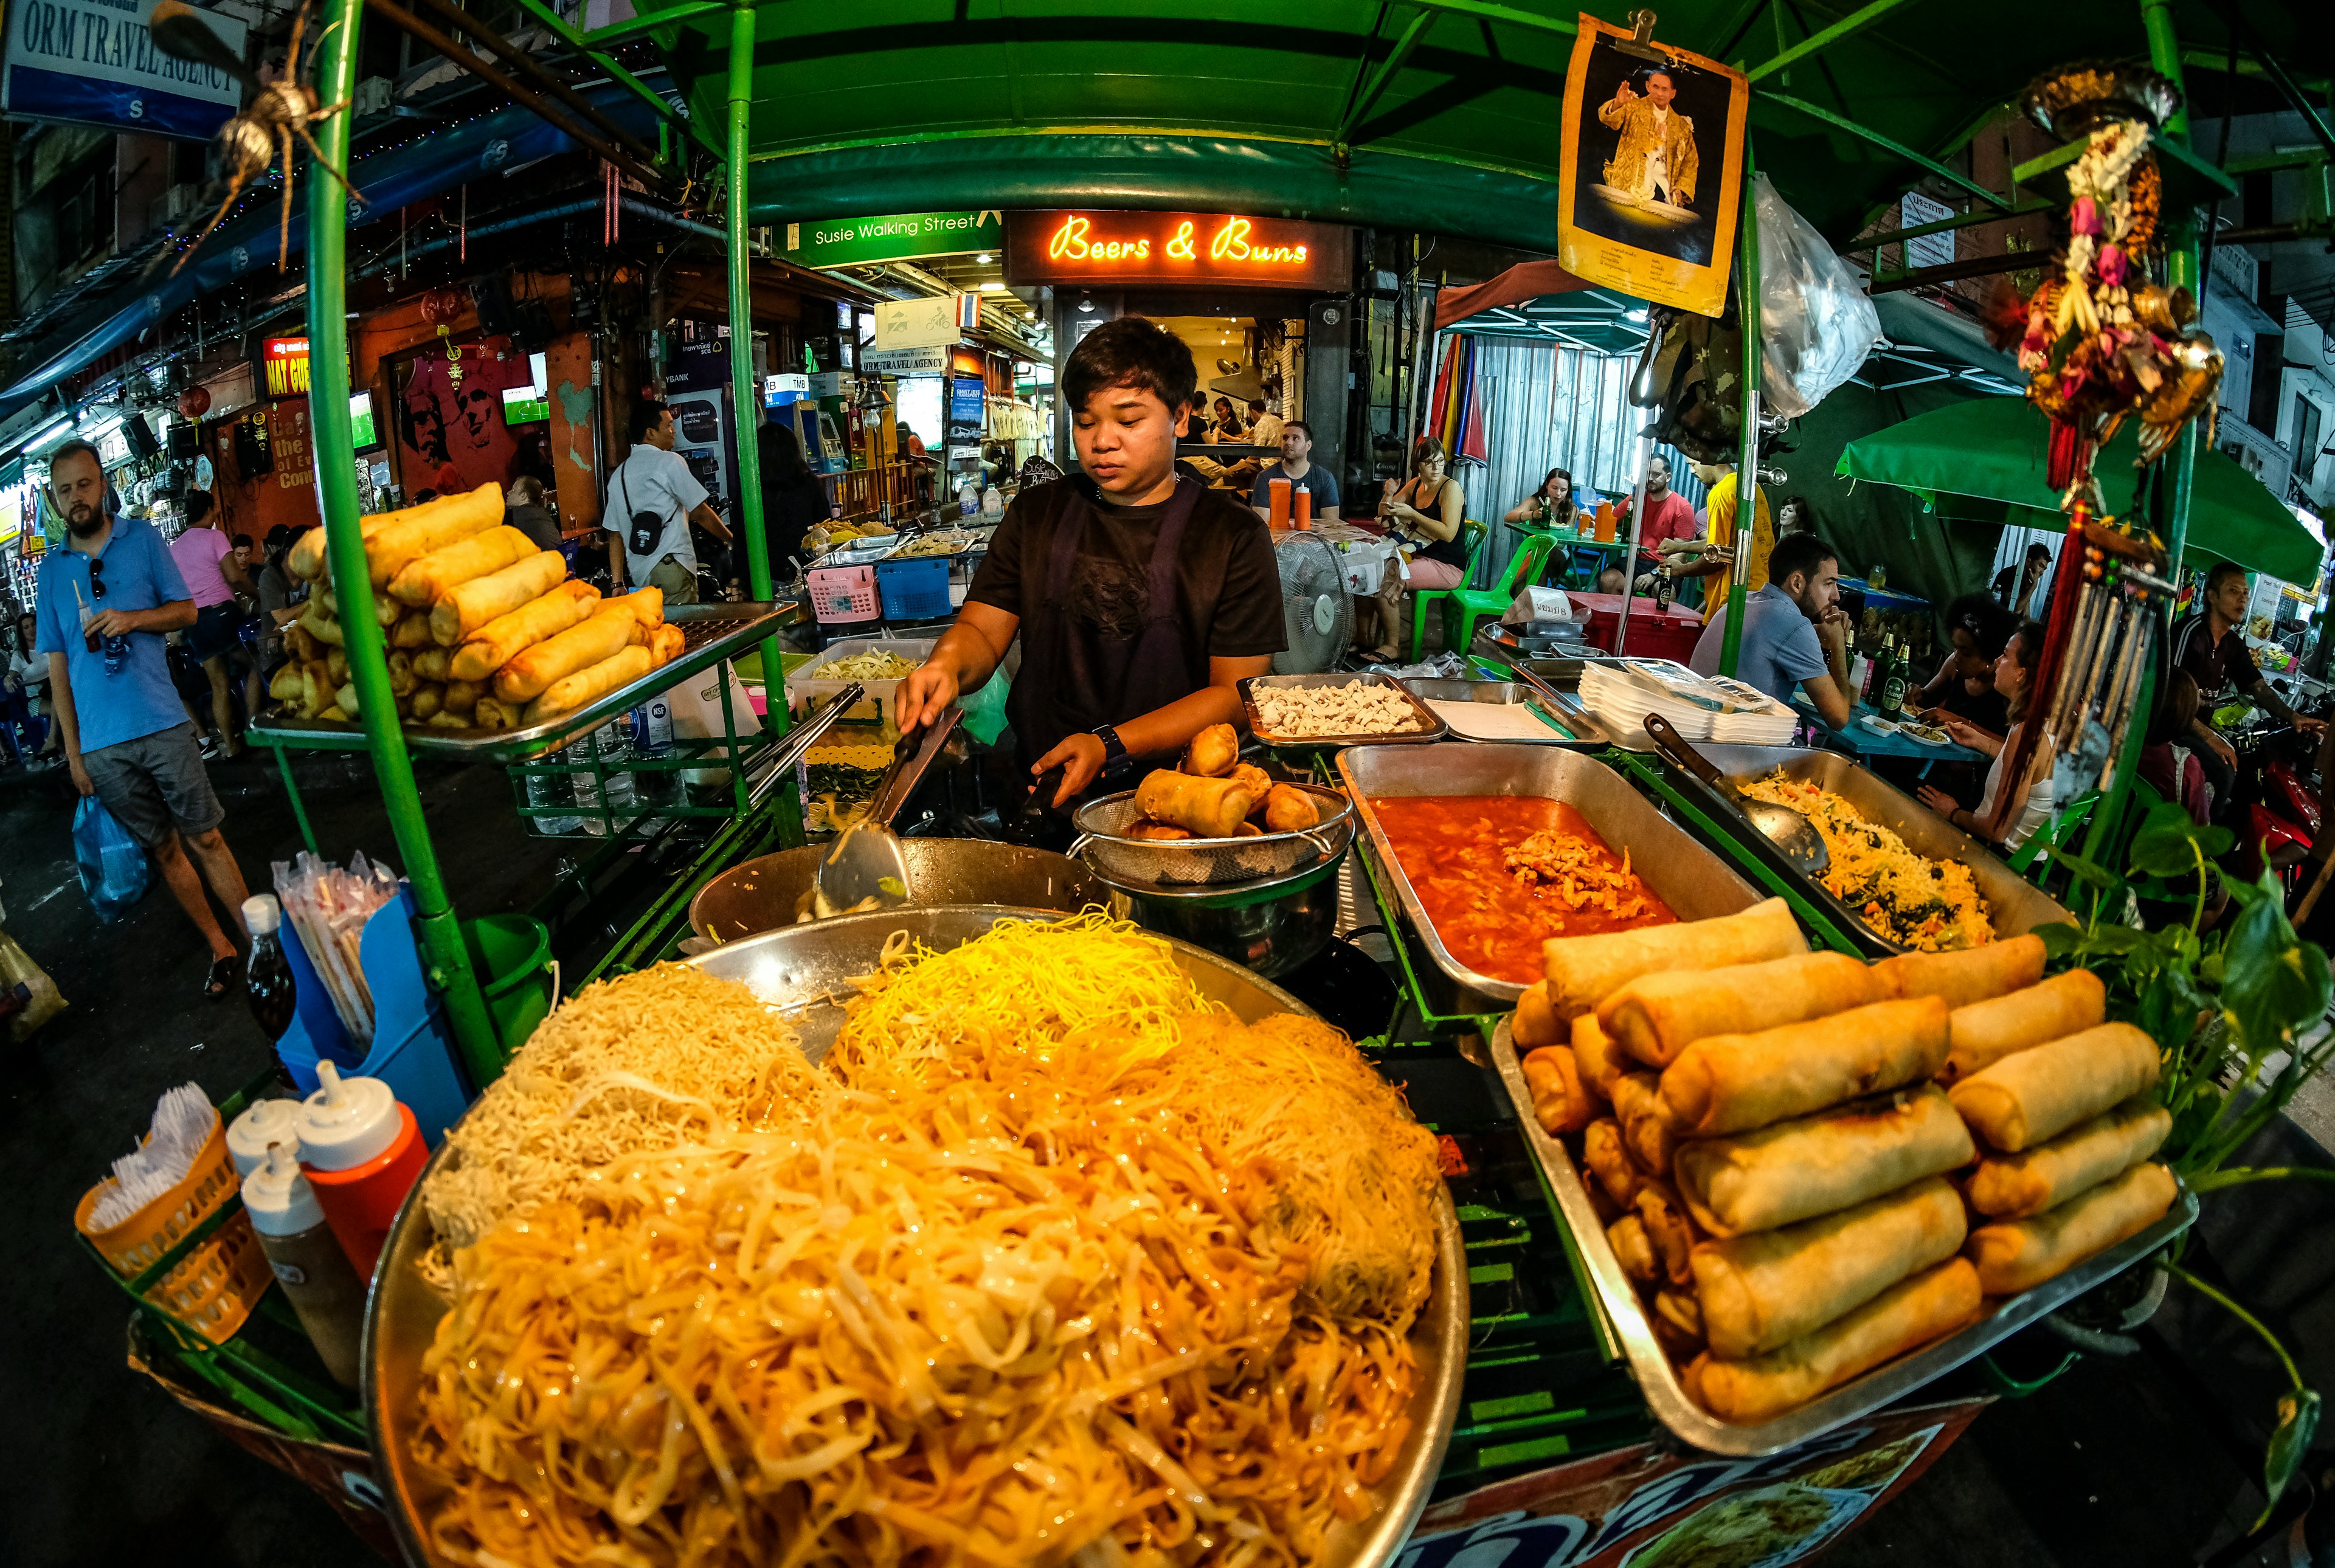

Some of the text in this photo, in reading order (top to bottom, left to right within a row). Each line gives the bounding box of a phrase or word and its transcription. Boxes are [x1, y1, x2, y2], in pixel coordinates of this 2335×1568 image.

[23, 0, 78, 59] ORM
[1912, 196, 1944, 215] ประกาศ
[816, 215, 975, 245] Susie Walking Street
[1050, 215, 1307, 263] Beers & Buns
[683, 342, 711, 351] ไทยพาณิชย์
[913, 359, 943, 368] AGENCY
[266, 357, 310, 395] NAT GUE
[666, 373, 689, 384] YBANK
[793, 379, 806, 389] TMB
[274, 439, 304, 458] the
[297, 456, 311, 467] Ev
[1025, 458, 1045, 473] Susie
[2261, 596, 2274, 606] Spring
[1885, 688, 1902, 699] Chang
[652, 706, 665, 716] NSF
